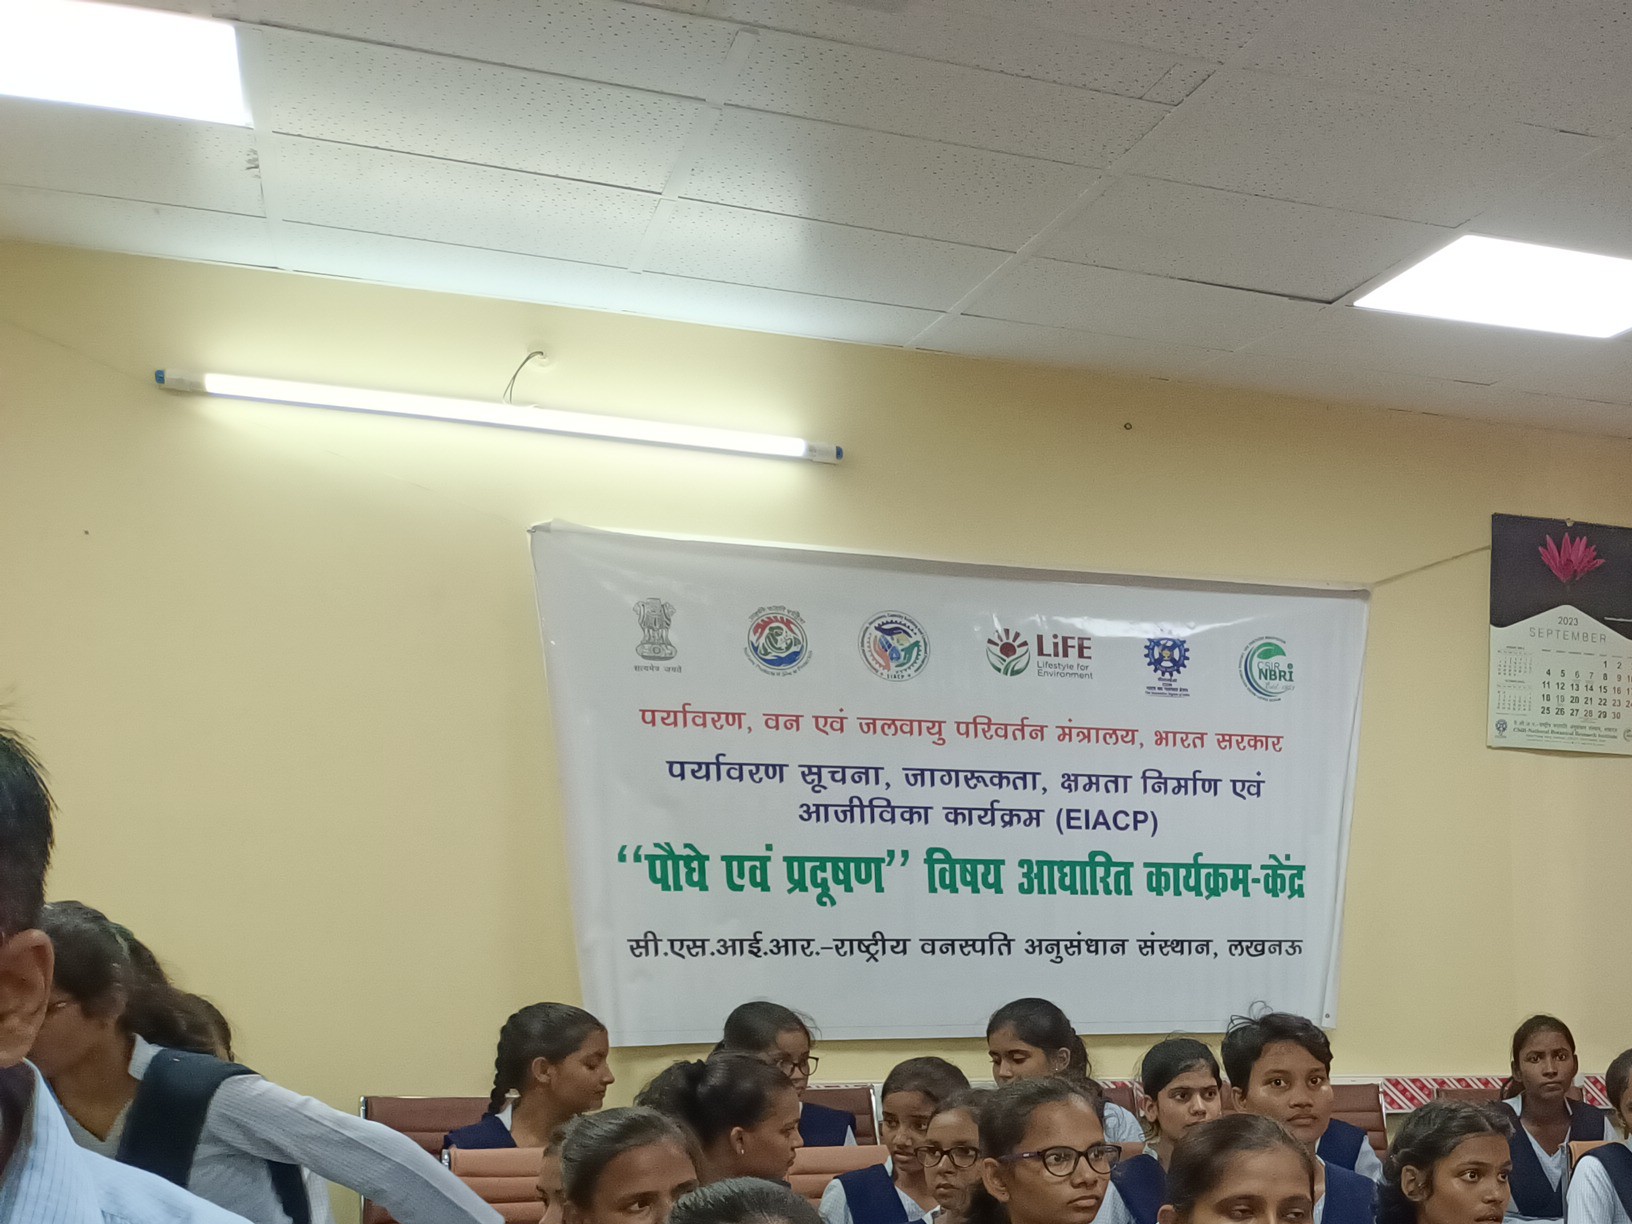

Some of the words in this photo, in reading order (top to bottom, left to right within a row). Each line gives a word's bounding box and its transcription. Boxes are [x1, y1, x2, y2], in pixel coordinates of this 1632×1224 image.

[1557, 616, 1579, 626] 2023
[1529, 627, 1607, 643] SEPTEMBER
[1036, 633, 1092, 659] LiFE
[1036, 660, 1075, 671] Lifestyle
[1076, 663, 1089, 671] for
[1256, 661, 1280, 671] CSIR
[1617, 662, 1622, 670] 2
[1037, 669, 1093, 679] Environment
[1560, 670, 1566, 678] 5
[1542, 681, 1551, 689] 11
[1556, 682, 1565, 691] 12
[1570, 683, 1580, 691] 13
[1584, 684, 1594, 692] 14
[1599, 685, 1608, 693] 15
[1584, 697, 1593, 705] 21
[1598, 698, 1608, 706] 22
[1540, 706, 1551, 715] 25
[1555, 707, 1565, 716] 26
[1570, 708, 1579, 717] 27
[639, 703, 752, 733] पर्यावरण,
[763, 714, 804, 732] वन
[812, 708, 848, 735] एवं
[857, 717, 946, 746] जलवायु
[954, 715, 1048, 741] परिवर्तन
[1055, 718, 1143, 748] मंत्रालय,
[1155, 730, 1208, 748] भारत
[1215, 733, 1284, 752] सरकार
[666, 753, 789, 783] पर्यावरण
[798, 765, 890, 793] सूचना,
[902, 768, 1047, 795] जागरूकता,
[1061, 773, 1132, 793] क्षमता
[1141, 769, 1222, 796] निर्माण
[1230, 771, 1265, 800] एवं
[799, 796, 933, 825] आजीविका
[942, 800, 1045, 828] कार्यक्रम
[1056, 808, 1158, 837] (EIACP)
[721, 844, 773, 892] एवं
[924, 847, 1005, 894] विषय
[919, 932, 1015, 956] वनस्पति
[1025, 931, 1129, 964] अनुसंधान
[1136, 931, 1218, 959] संस्थान,
[1227, 940, 1303, 957] लखनऊ
